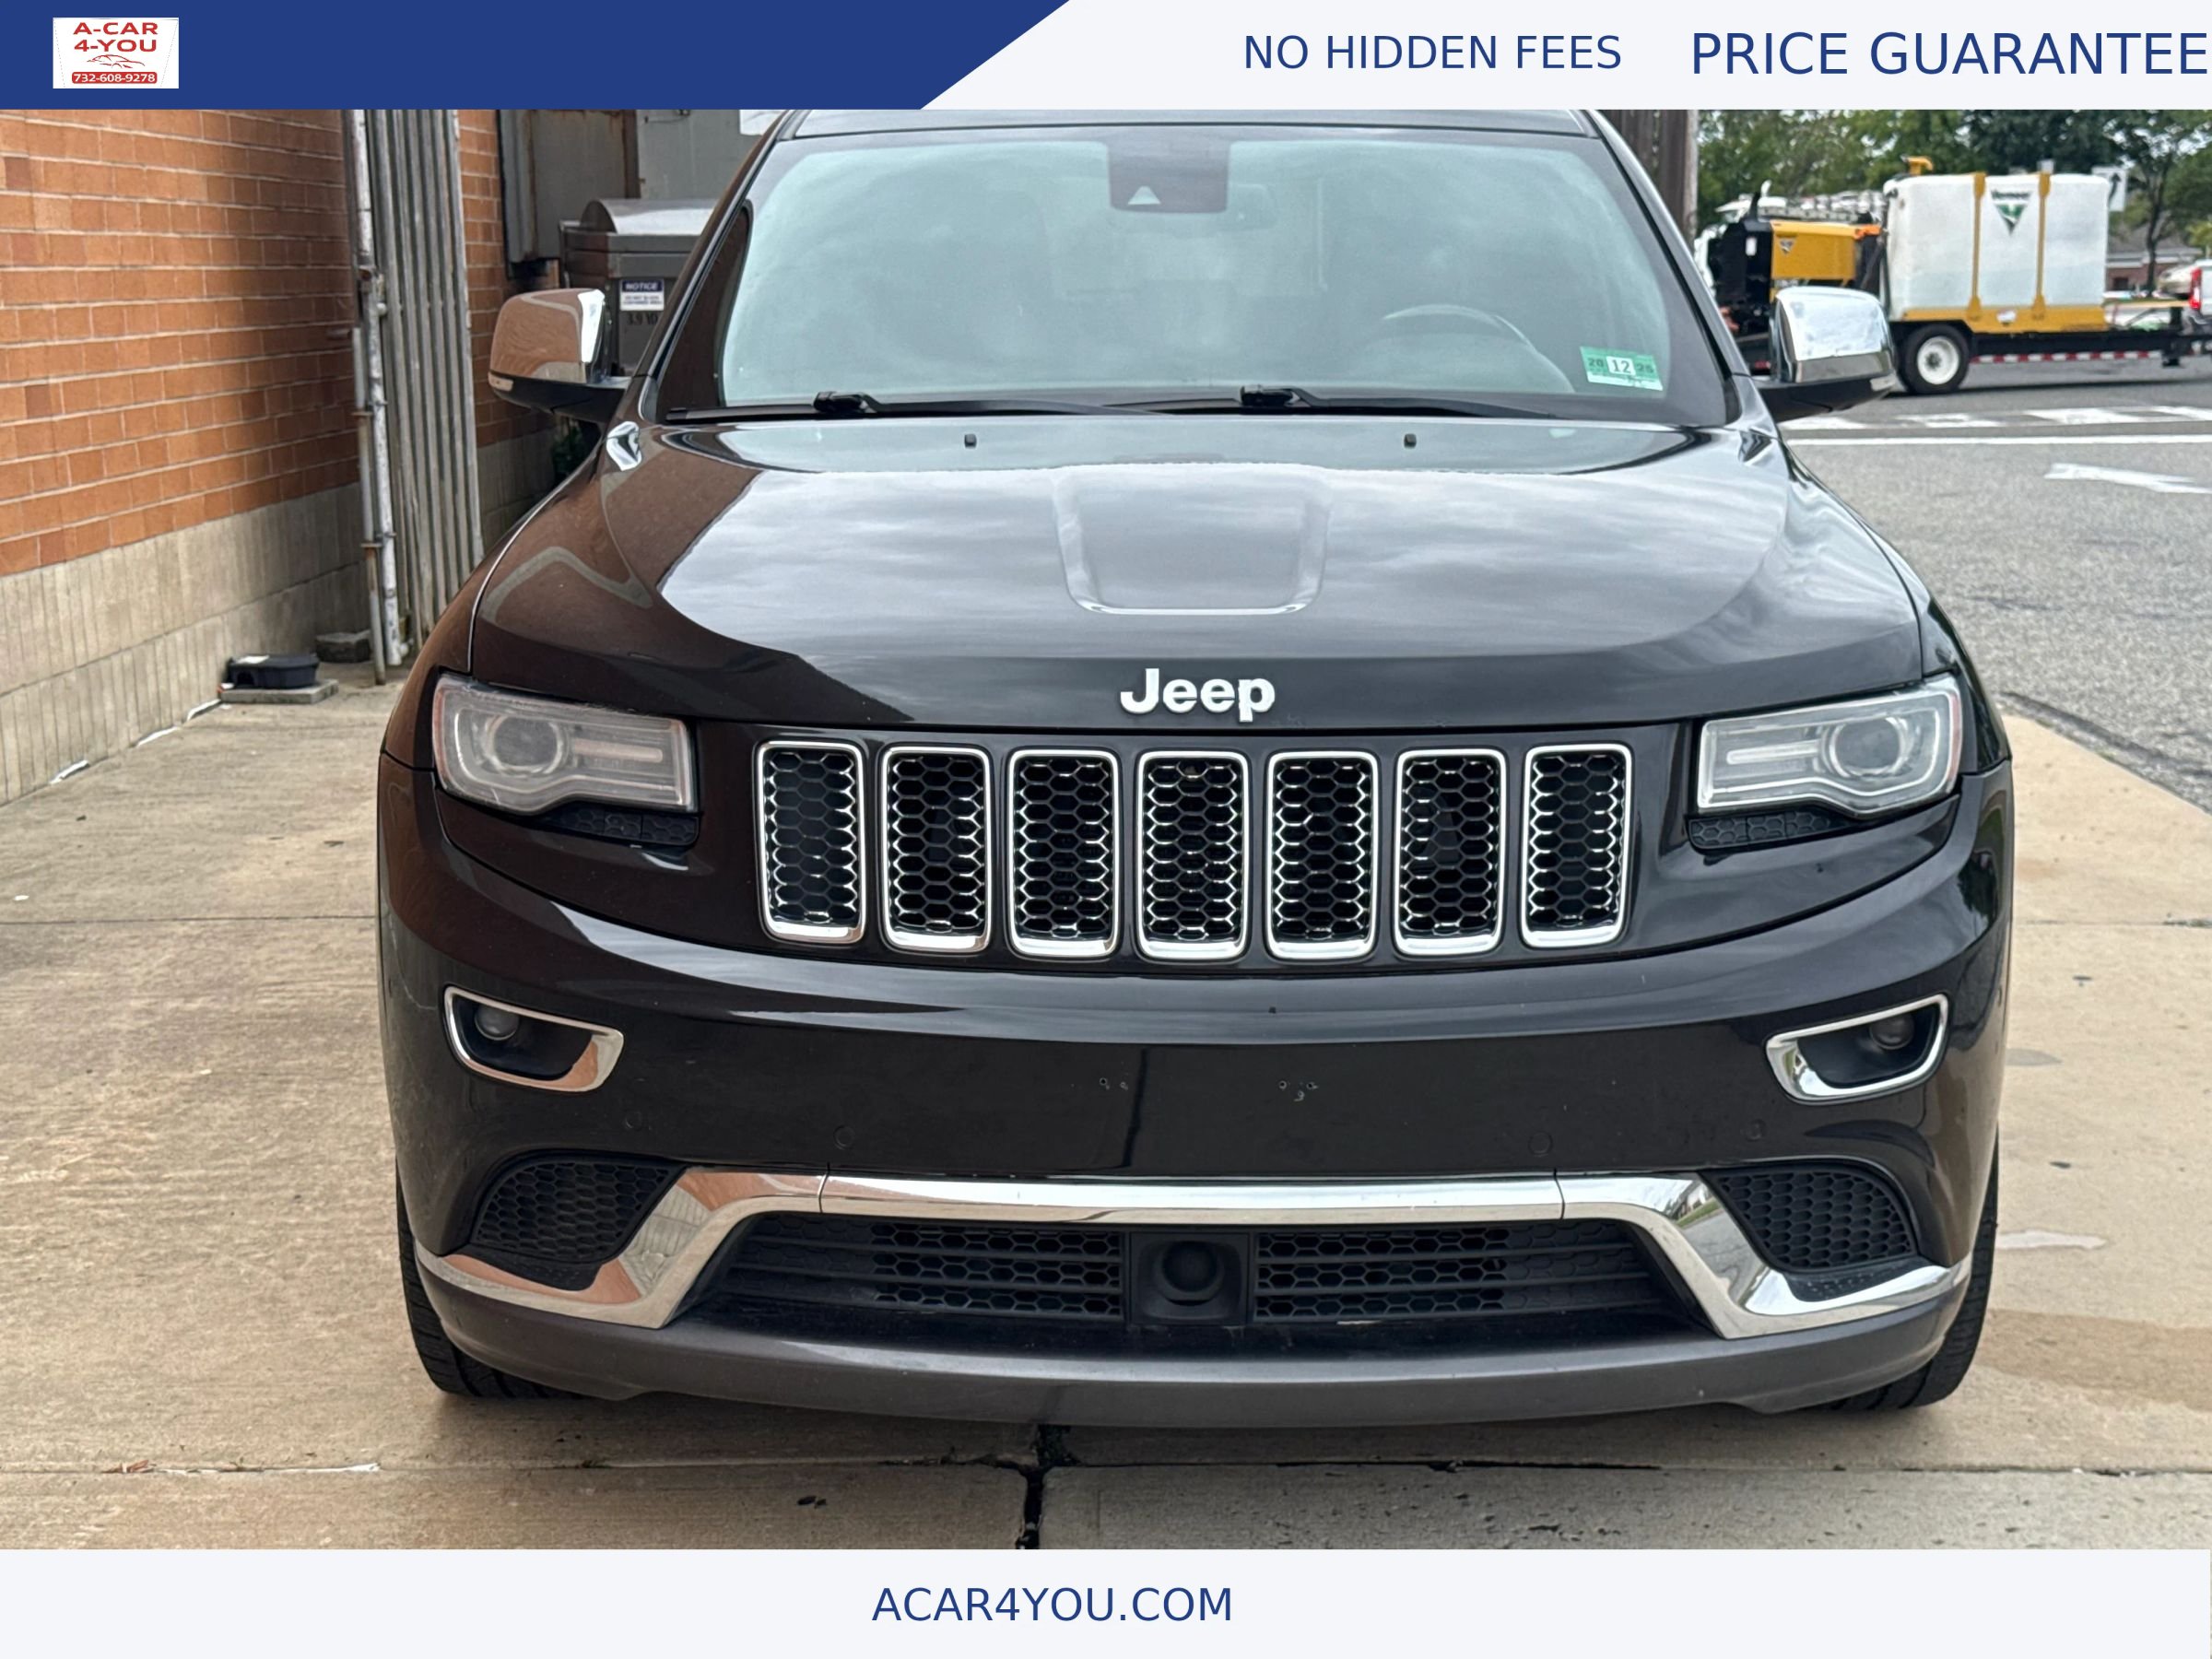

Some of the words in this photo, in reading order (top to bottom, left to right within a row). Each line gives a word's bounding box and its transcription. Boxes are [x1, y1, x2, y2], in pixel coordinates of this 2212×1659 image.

[625, 282, 657, 290] NOTICE
[1611, 359, 1631, 374] 12
[1120, 667, 1276, 722] Jeep
